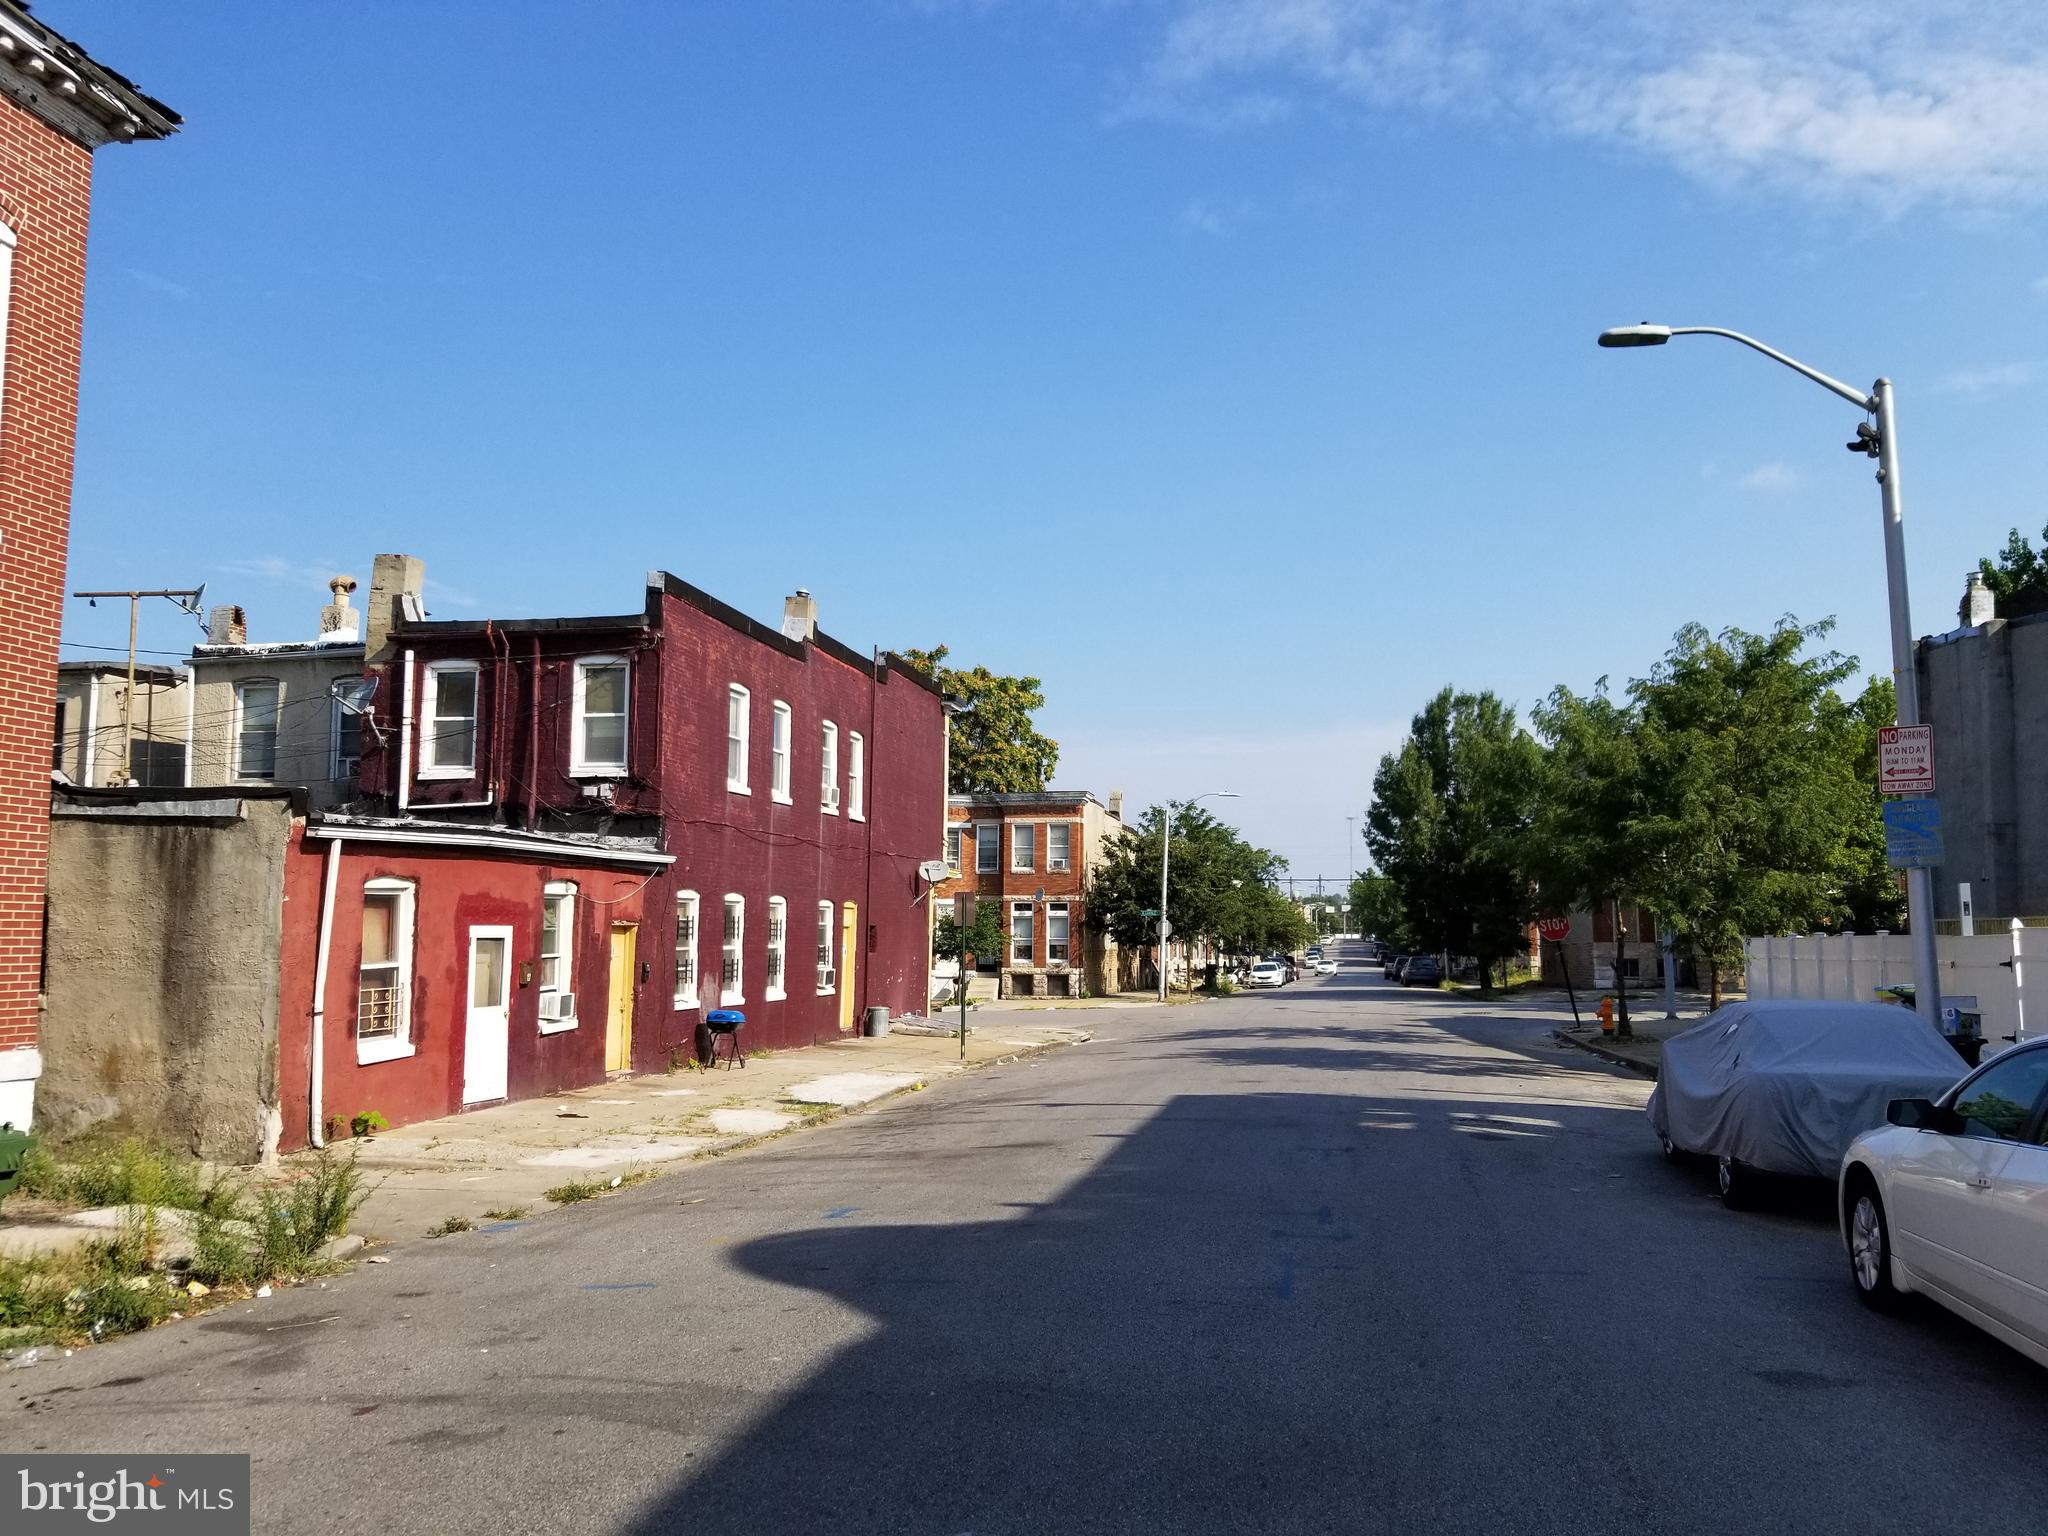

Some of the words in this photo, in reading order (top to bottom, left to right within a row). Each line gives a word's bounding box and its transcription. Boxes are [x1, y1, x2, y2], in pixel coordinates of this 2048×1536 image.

[1881, 730, 1898, 744] NO
[1899, 730, 1929, 741] PARKING
[1885, 745, 1927, 755] MONDAY
[1910, 756, 1924, 764] 11AM
[1883, 782, 1896, 790] TOW
[1915, 780, 1931, 789] ZONE
[1539, 917, 1567, 932] STOP
